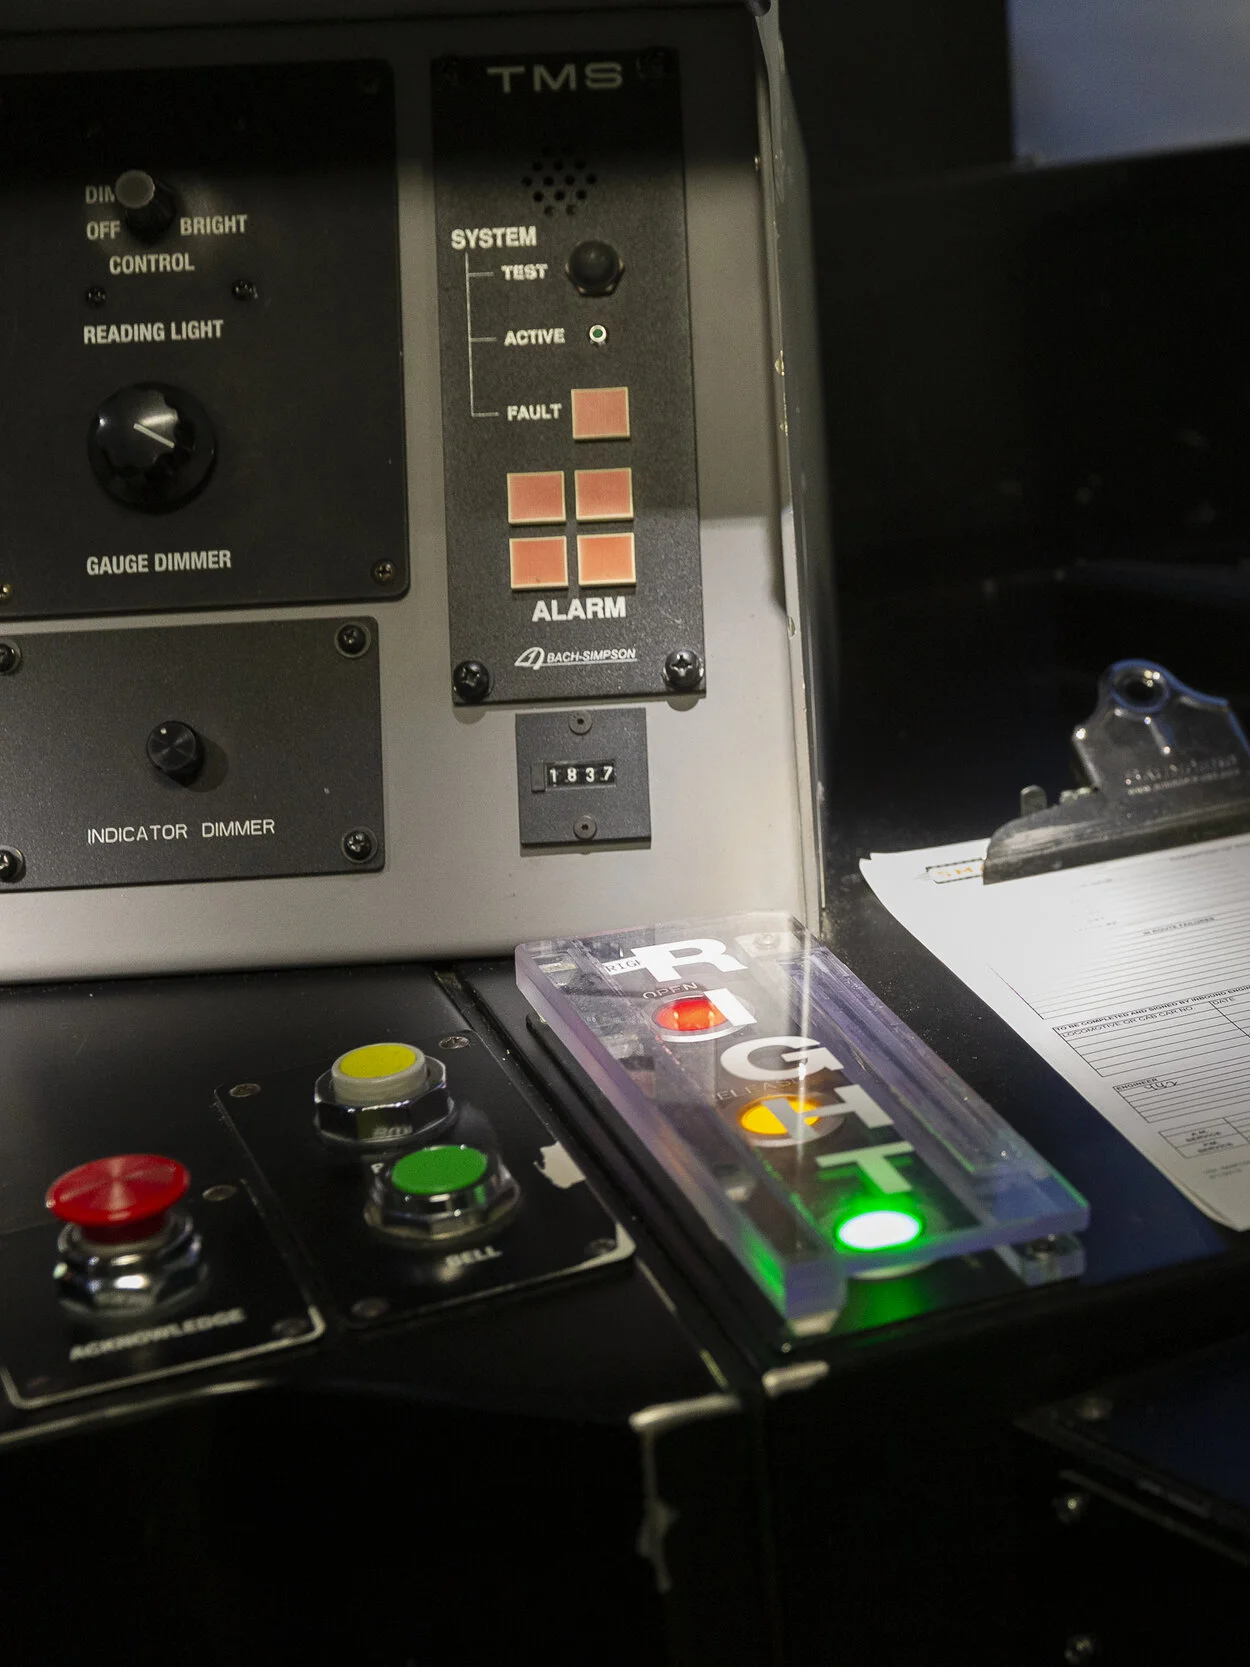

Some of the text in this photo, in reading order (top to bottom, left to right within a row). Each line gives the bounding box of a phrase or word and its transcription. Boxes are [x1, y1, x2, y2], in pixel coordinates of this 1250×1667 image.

[487, 61, 624, 93] TMS
[86, 220, 120, 240] OFF
[180, 214, 248, 236] BRIGHT
[451, 226, 538, 250] SYSTEM
[109, 252, 195, 275] CONTROL
[501, 263, 549, 281] TEST
[83, 319, 224, 345] READING LIGHT
[504, 327, 566, 347] ACTIVE
[507, 403, 562, 421] FAULT
[86, 549, 232, 576] GAUGE DIMMER
[531, 596, 627, 622] ALARM
[546, 647, 637, 664] BACH-SIMPSON
[87, 818, 276, 846] INDICATOR DIMMER
[642, 982, 699, 1000] OPEN
[1211, 996, 1236, 1006] DATE
[1060, 1021, 1121, 1038] LOCOMOTIVE
[1116, 1077, 1158, 1091] ENGINEER
[68, 1307, 248, 1362] ACKNOWLEDGE
